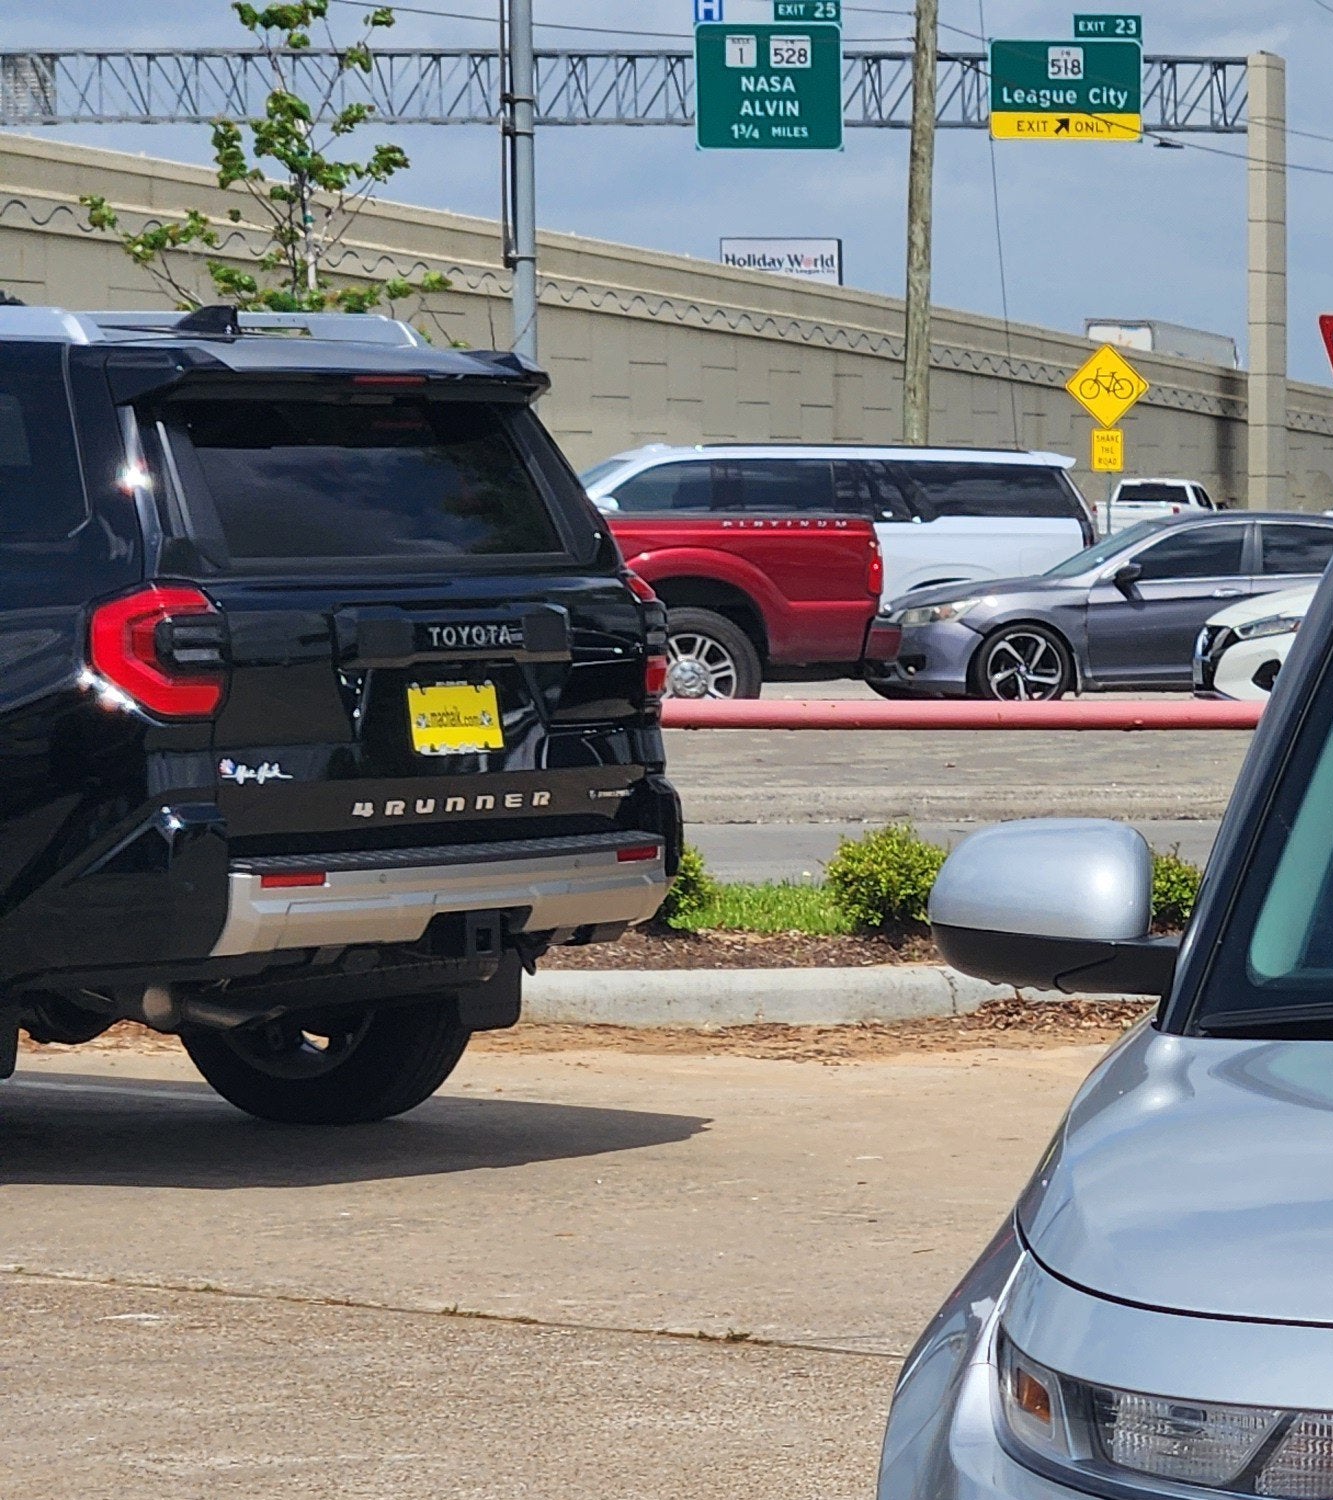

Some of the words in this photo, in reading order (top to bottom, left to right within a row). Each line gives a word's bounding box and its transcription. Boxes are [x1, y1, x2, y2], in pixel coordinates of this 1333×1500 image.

[777, 4, 805, 16] EXIT
[813, 2, 836, 18] 25
[1078, 21, 1105, 32] EXIT
[1115, 19, 1137, 34] 23
[738, 47, 744, 65] 1
[773, 48, 808, 65] 528
[1050, 58, 1081, 76] 518
[740, 76, 796, 93] NASA
[1002, 86, 1077, 108] League
[1089, 86, 1128, 109] City
[739, 100, 800, 117] ALVIN
[771, 126, 809, 138] MILES
[1017, 120, 1049, 132] EXIT
[1075, 121, 1114, 133] ONLY
[725, 253, 784, 270] Holiday
[787, 253, 835, 268] World
[1096, 435, 1119, 443] SHARE
[1101, 446, 1115, 455] THE
[1098, 458, 1117, 466] ROAD
[428, 625, 512, 647] TOYOTA
[352, 790, 551, 818] 4RUNNER
